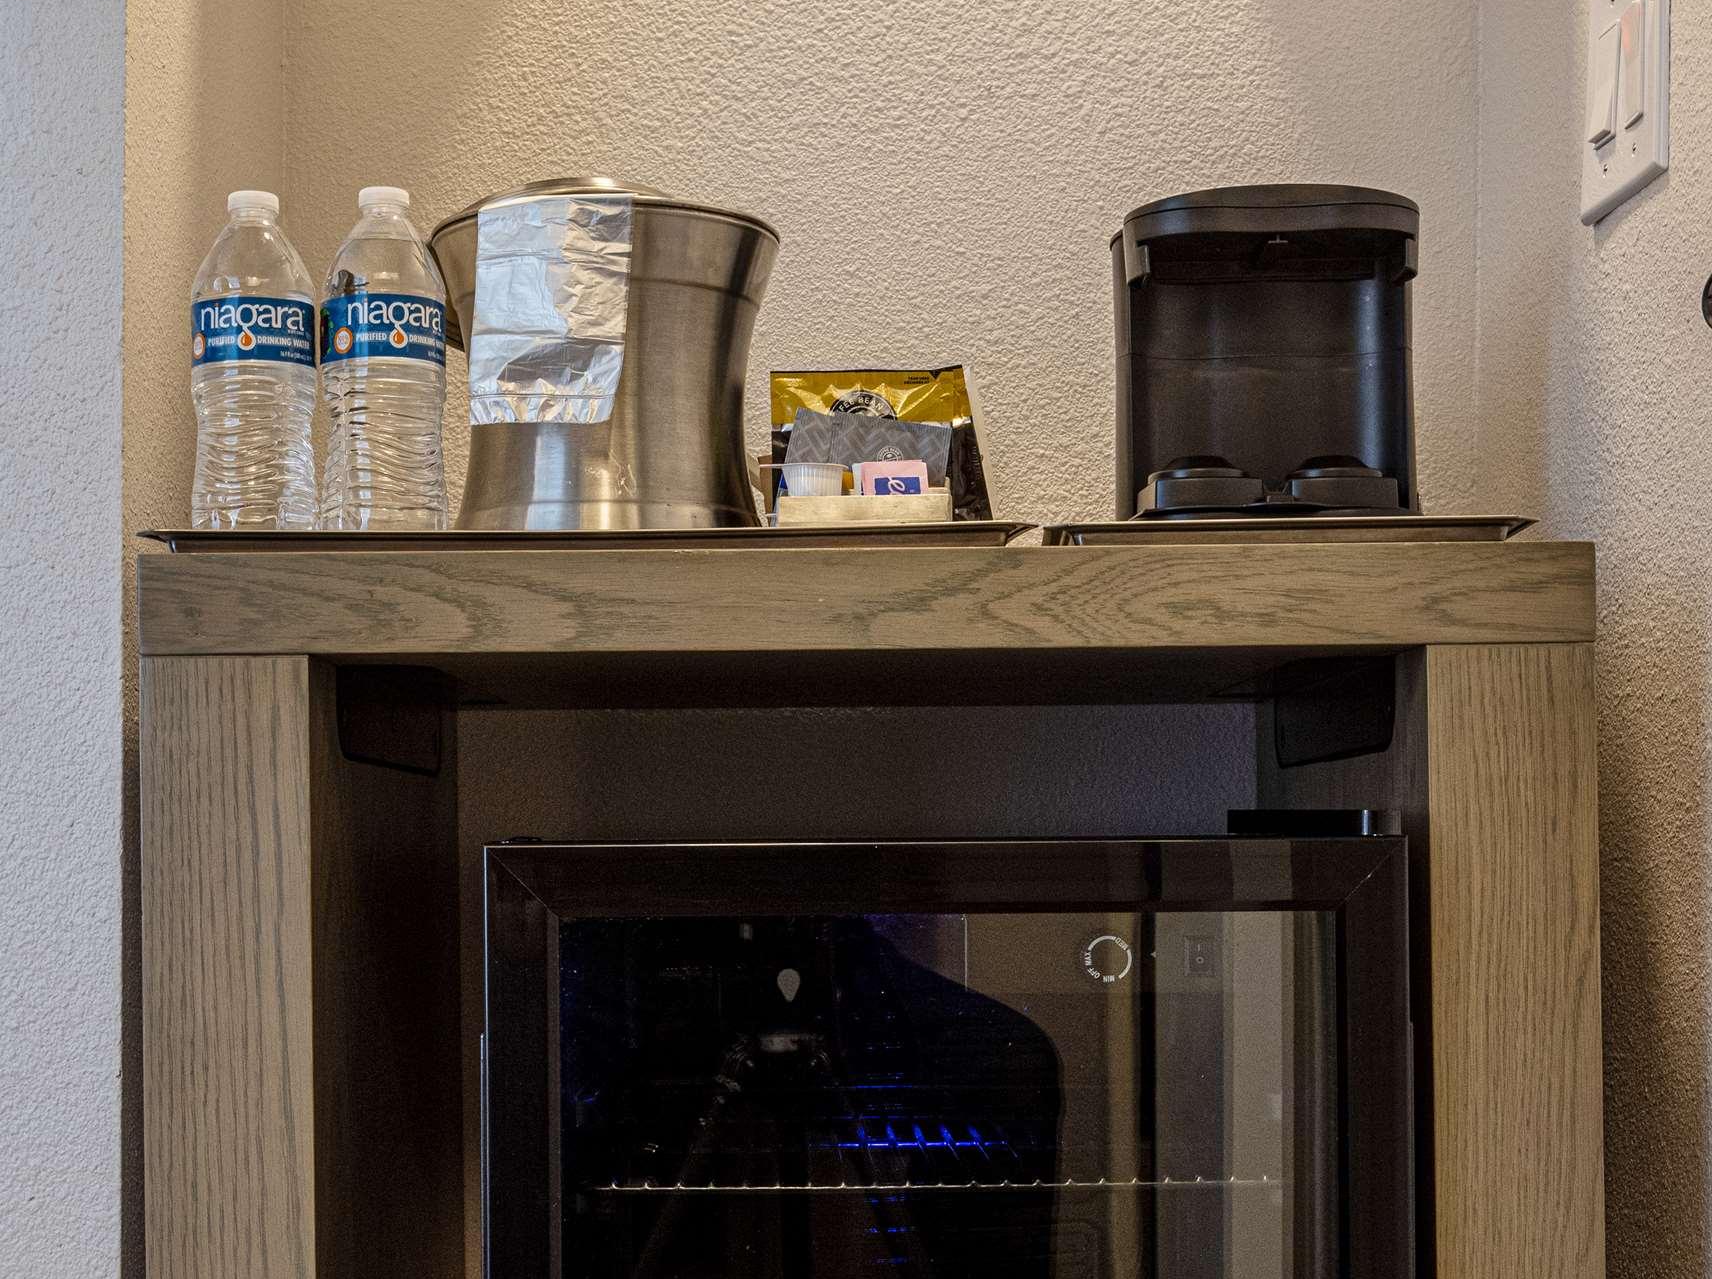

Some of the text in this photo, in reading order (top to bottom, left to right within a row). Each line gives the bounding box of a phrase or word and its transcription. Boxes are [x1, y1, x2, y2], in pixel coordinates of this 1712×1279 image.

[201, 303, 304, 332] niagara
[347, 300, 442, 332] niagara
[207, 335, 310, 349] PURIFIED DRINKING WATER
[355, 332, 387, 342] PURIFIED
[1084, 951, 1092, 966] MAX
[1087, 967, 1101, 979] OFF
